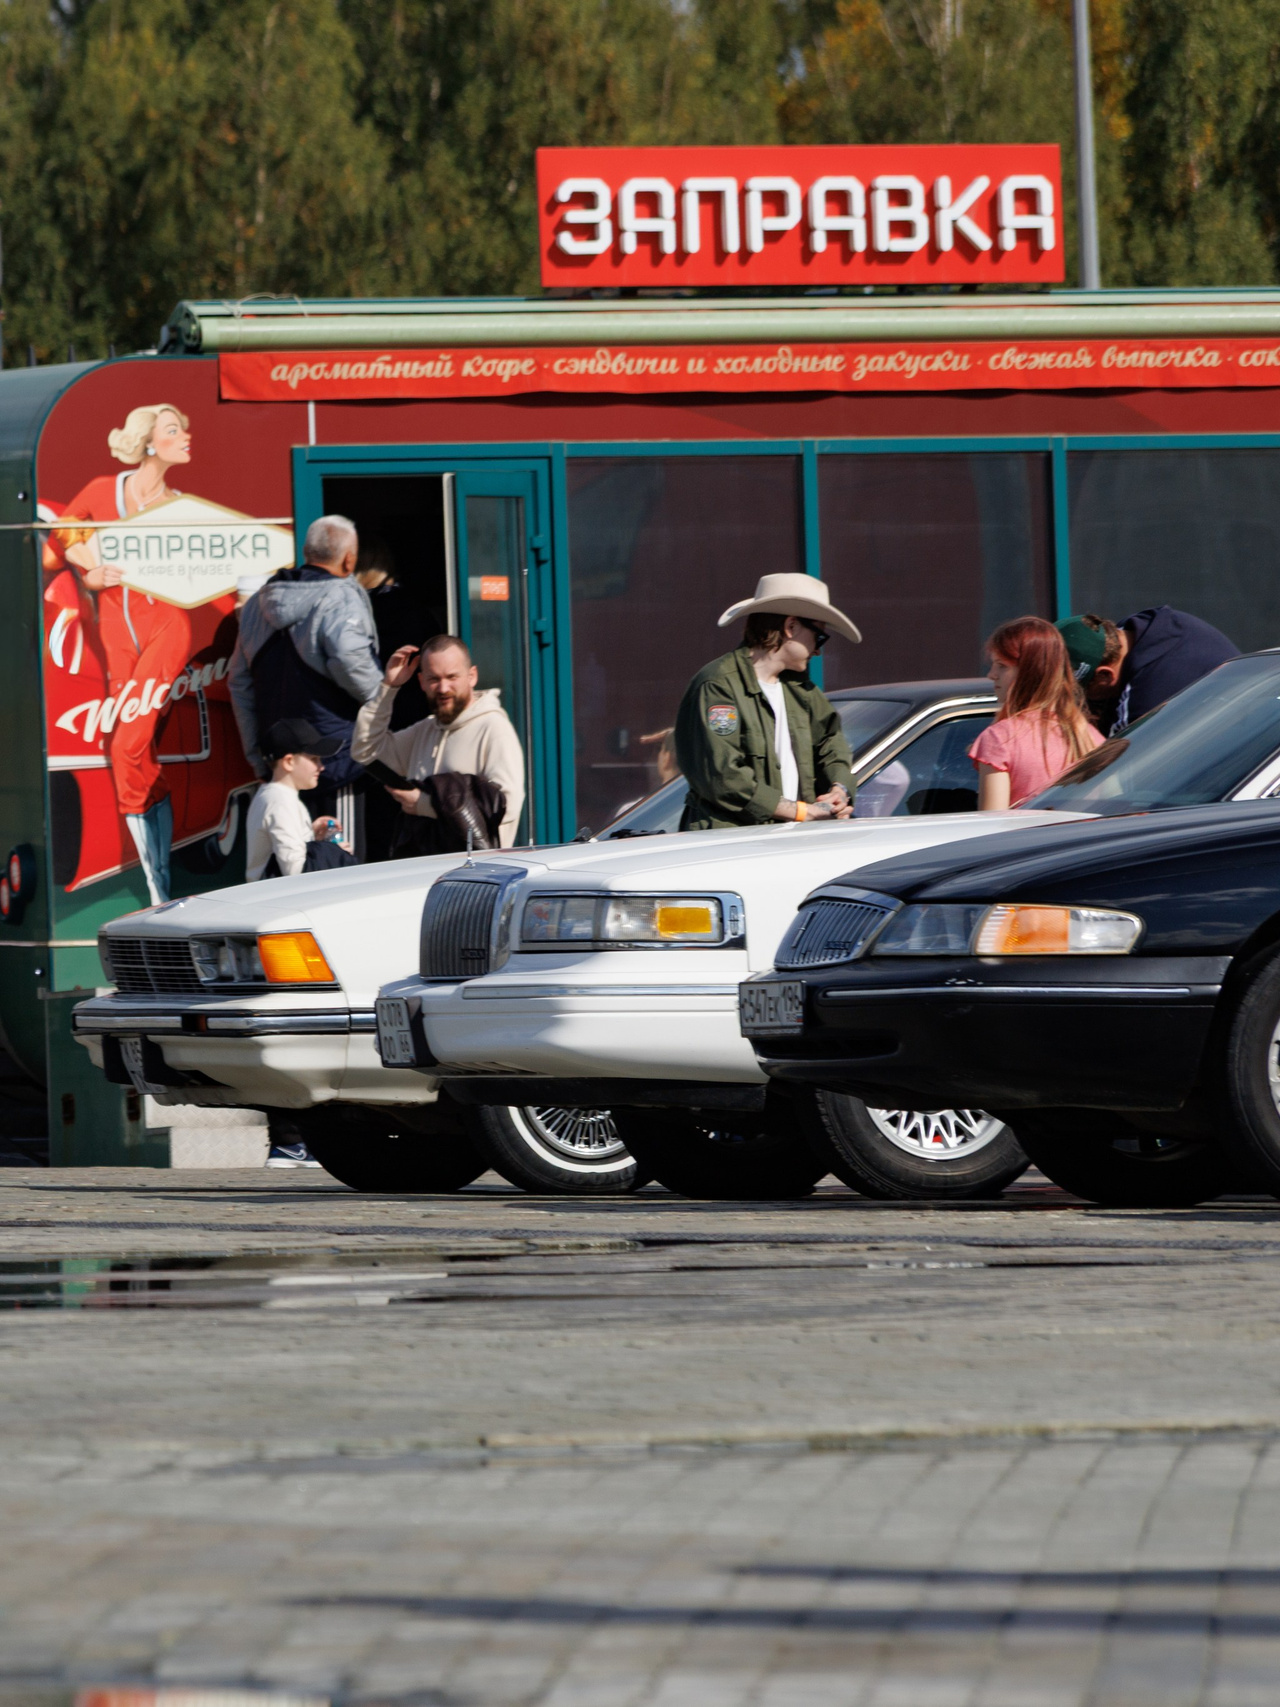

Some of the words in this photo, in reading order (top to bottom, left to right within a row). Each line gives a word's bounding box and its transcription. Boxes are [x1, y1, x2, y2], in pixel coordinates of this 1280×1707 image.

[556, 175, 1055, 255] ЗАПРАВКА
[271, 354, 455, 390] ароматный
[461, 355, 536, 383] кофе
[553, 348, 680, 375] сэндвичи
[686, 357, 707, 374] и
[713, 346, 847, 374] холодные
[851, 350, 973, 381] закуски
[988, 346, 1096, 371] свежая
[1101, 345, 1222, 369] выпечка
[101, 534, 271, 561] ЗАПРАВКА
[138, 564, 176, 577] КАФЕ
[177, 564, 186, 576] В
[188, 563, 235, 577] МУЗЕЕ
[55, 656, 235, 743] Welcom
